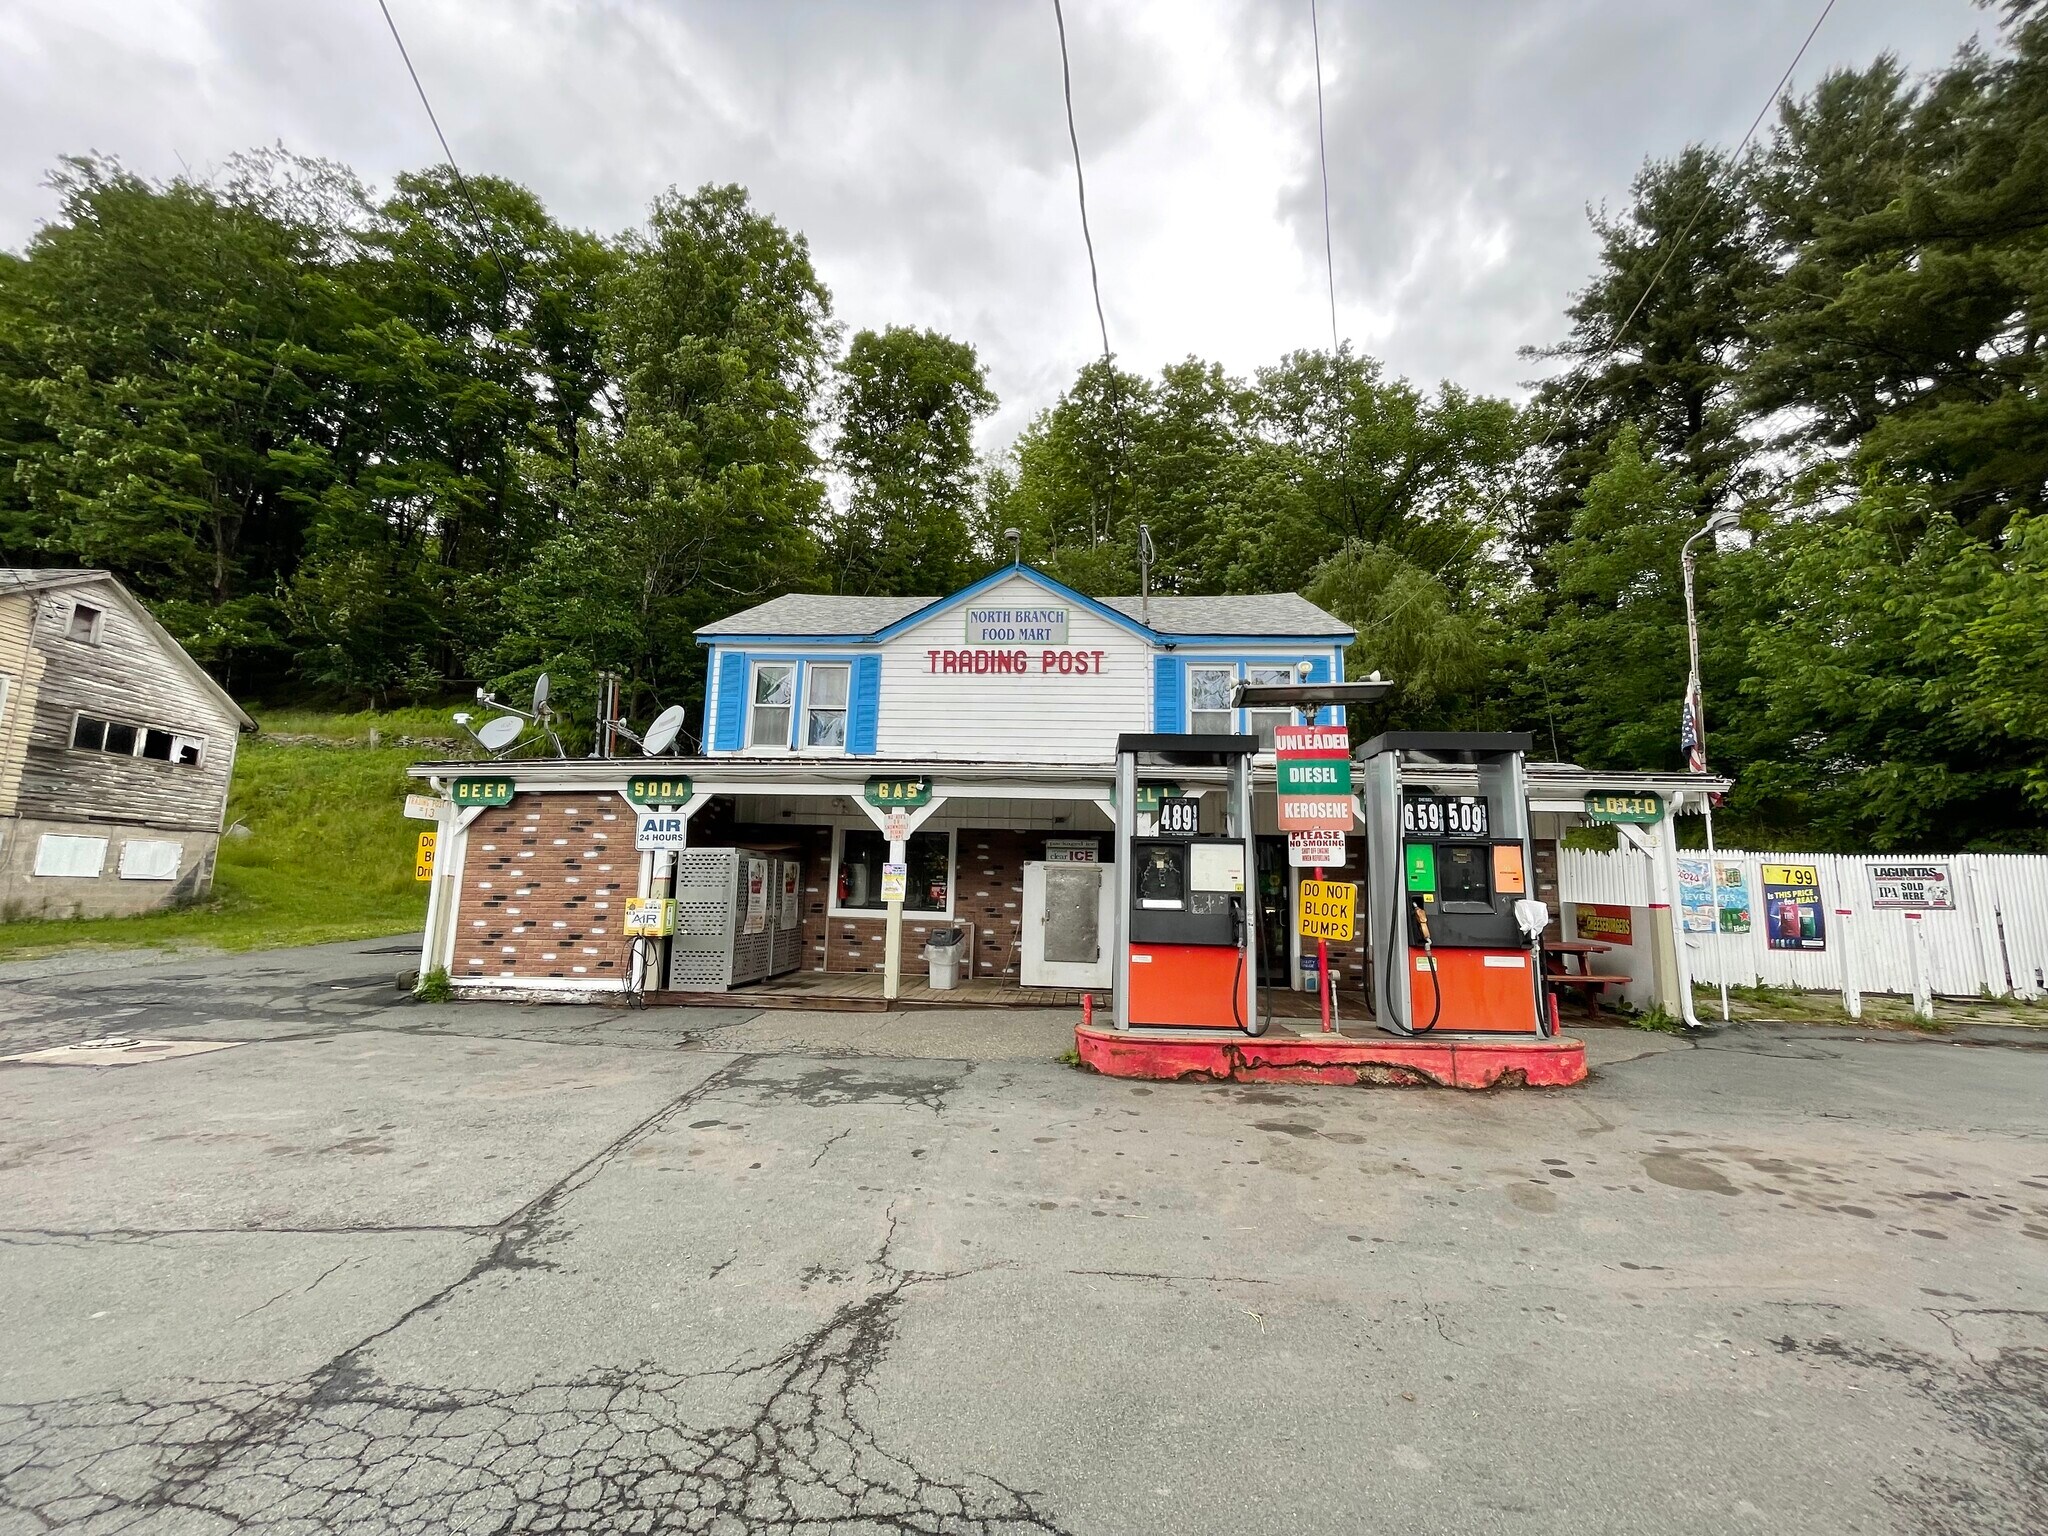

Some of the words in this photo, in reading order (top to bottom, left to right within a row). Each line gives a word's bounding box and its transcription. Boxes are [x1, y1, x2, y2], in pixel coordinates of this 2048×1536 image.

[970, 611, 1011, 623] NORTH
[1015, 610, 1064, 623] BRANCH
[982, 628, 1015, 641] FOOD
[1019, 628, 1052, 641] MART
[927, 650, 1028, 675] TRADING
[1042, 650, 1105, 675] POST
[1276, 734, 1349, 751] UNLEADED
[1289, 767, 1338, 783] DIESEL
[459, 783, 507, 798] BEER
[634, 782, 685, 797] SODA
[878, 783, 918, 798] GAS
[1284, 802, 1349, 819] KEROSENE
[1593, 797, 1657, 815] LOTTO
[642, 819, 681, 832] AIR
[639, 833, 650, 841] 24
[652, 833, 684, 841] HOURS
[1291, 831, 1341, 840] PLEASE
[421, 836, 434, 848] Do
[1289, 840, 1301, 848] NO
[1303, 840, 1344, 848] SMOKING
[424, 851, 434, 862] Bl
[1069, 850, 1094, 861] ICE
[417, 866, 433, 877] Driv
[1782, 869, 1813, 885] 7.99
[1873, 867, 1938, 877] LAGUNITAS
[1304, 883, 1320, 897] DO
[1326, 885, 1351, 900] NOT
[1878, 886, 1898, 898] IPA
[1900, 882, 1924, 891] SOLD
[1681, 893, 1736, 902] BEVERGES
[1774, 890, 1792, 899] THIS
[1792, 888, 1814, 898] PRICE
[1902, 892, 1925, 900] HERE
[1795, 895, 1819, 905] REAL?
[1304, 901, 1348, 919] BLOCK
[631, 914, 657, 924] AIR
[1302, 919, 1349, 938] PUMPS
